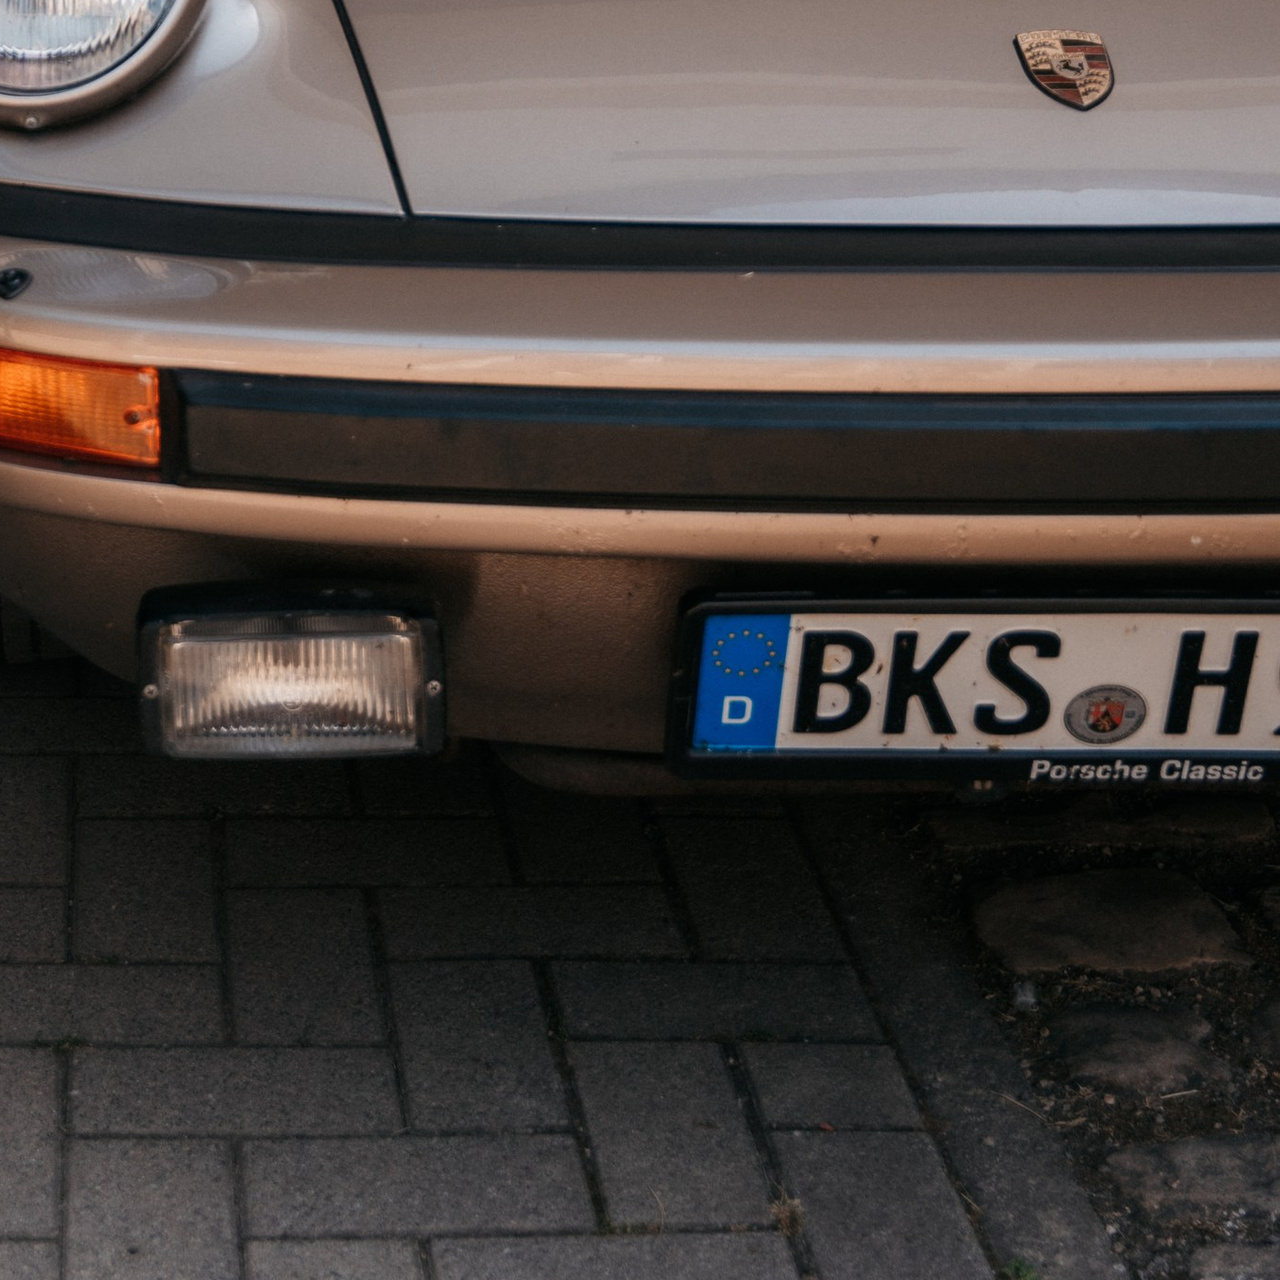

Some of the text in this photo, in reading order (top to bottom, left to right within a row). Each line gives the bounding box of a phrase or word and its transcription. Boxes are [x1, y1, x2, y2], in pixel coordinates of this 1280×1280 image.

[721, 696, 753, 725] D
[791, 629, 1062, 735] BKS
[1162, 629, 1280, 736] H
[1029, 758, 1264, 781] Porsche Classic
